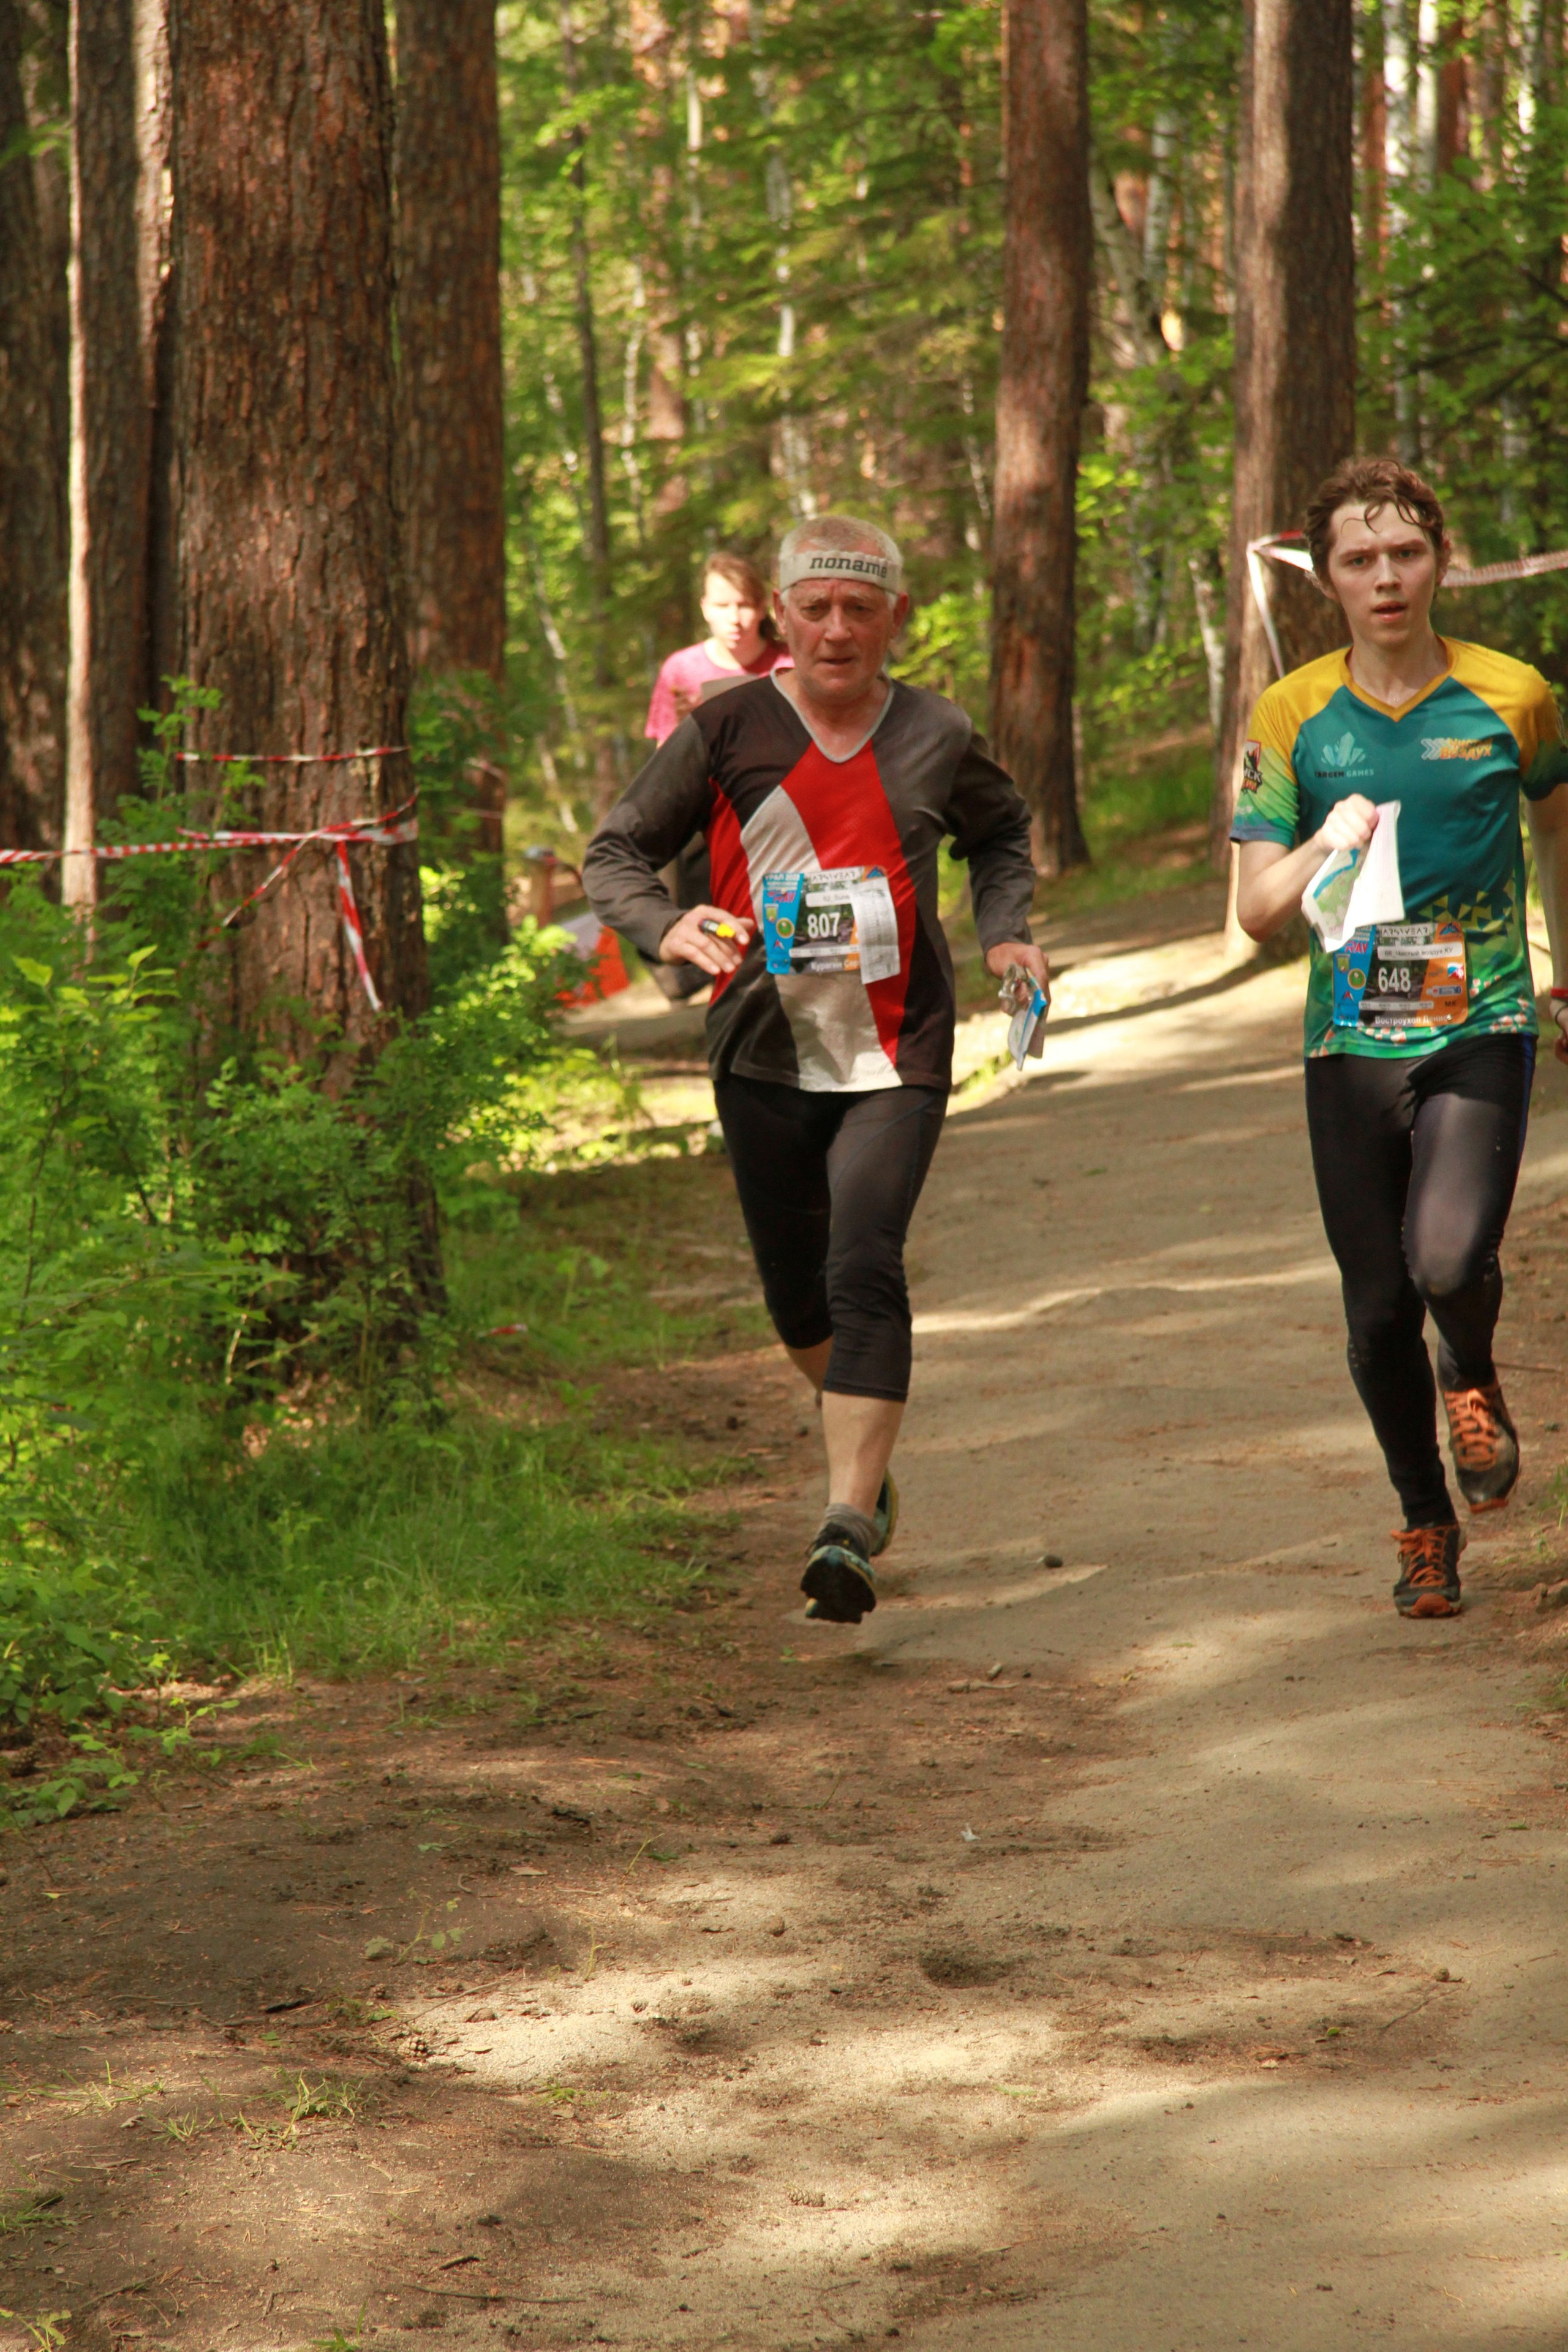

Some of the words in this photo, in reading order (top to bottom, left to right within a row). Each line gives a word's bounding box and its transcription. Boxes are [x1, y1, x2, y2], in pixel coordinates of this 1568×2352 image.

[810, 557, 887, 578] noname
[1346, 769, 1374, 777] GAMES
[807, 912, 840, 938] 807
[1378, 967, 1411, 992] 648
